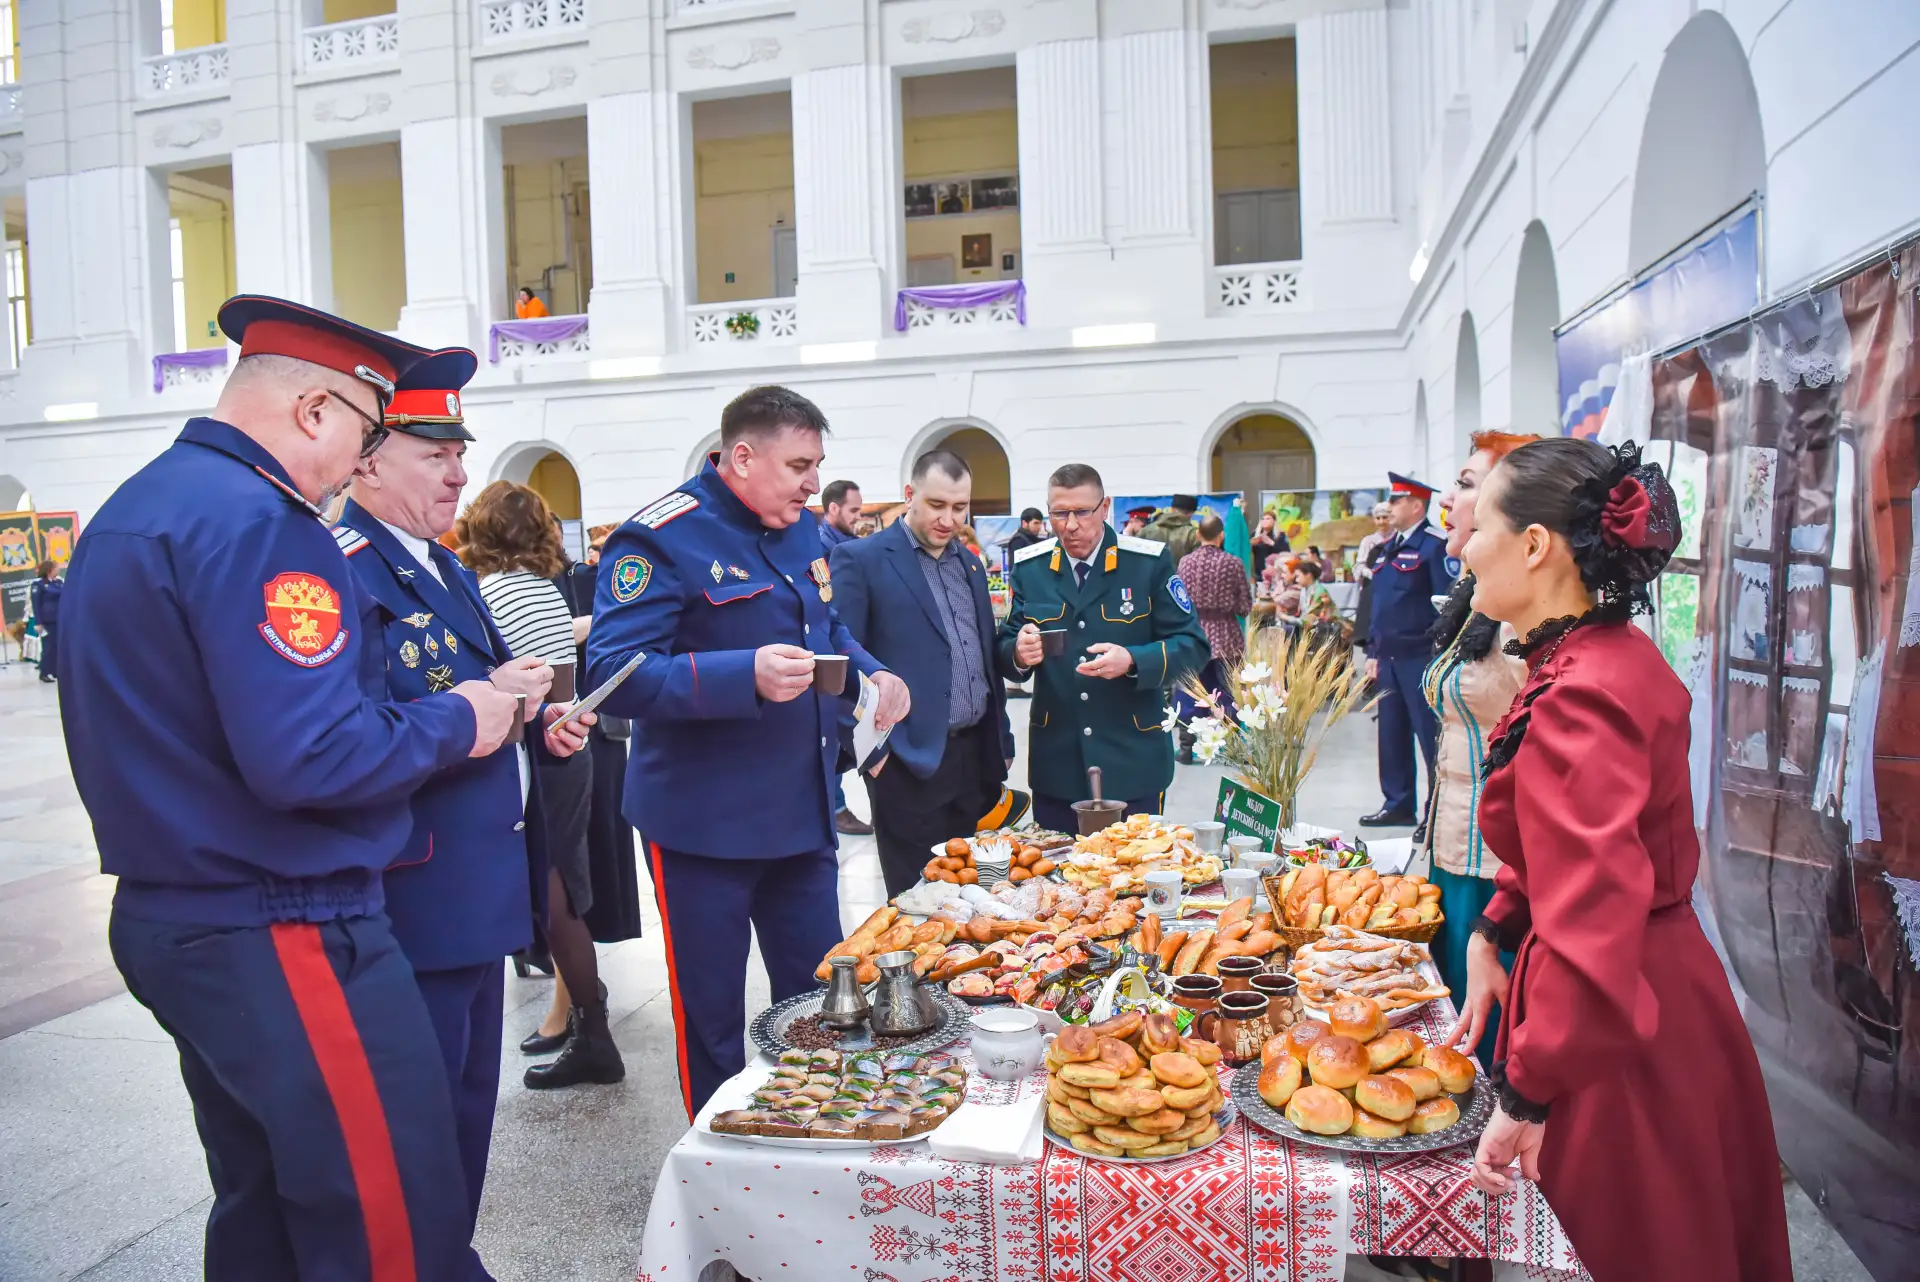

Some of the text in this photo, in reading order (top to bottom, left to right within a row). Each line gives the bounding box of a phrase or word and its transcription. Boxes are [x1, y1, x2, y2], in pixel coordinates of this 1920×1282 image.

[264, 625, 307, 663] ЦЕНТРАЛЬНОЕ
[1246, 797, 1264, 814] МБДОУ
[1231, 808, 1255, 829] ДЕТСКИЙ
[1253, 820, 1265, 837] САД
